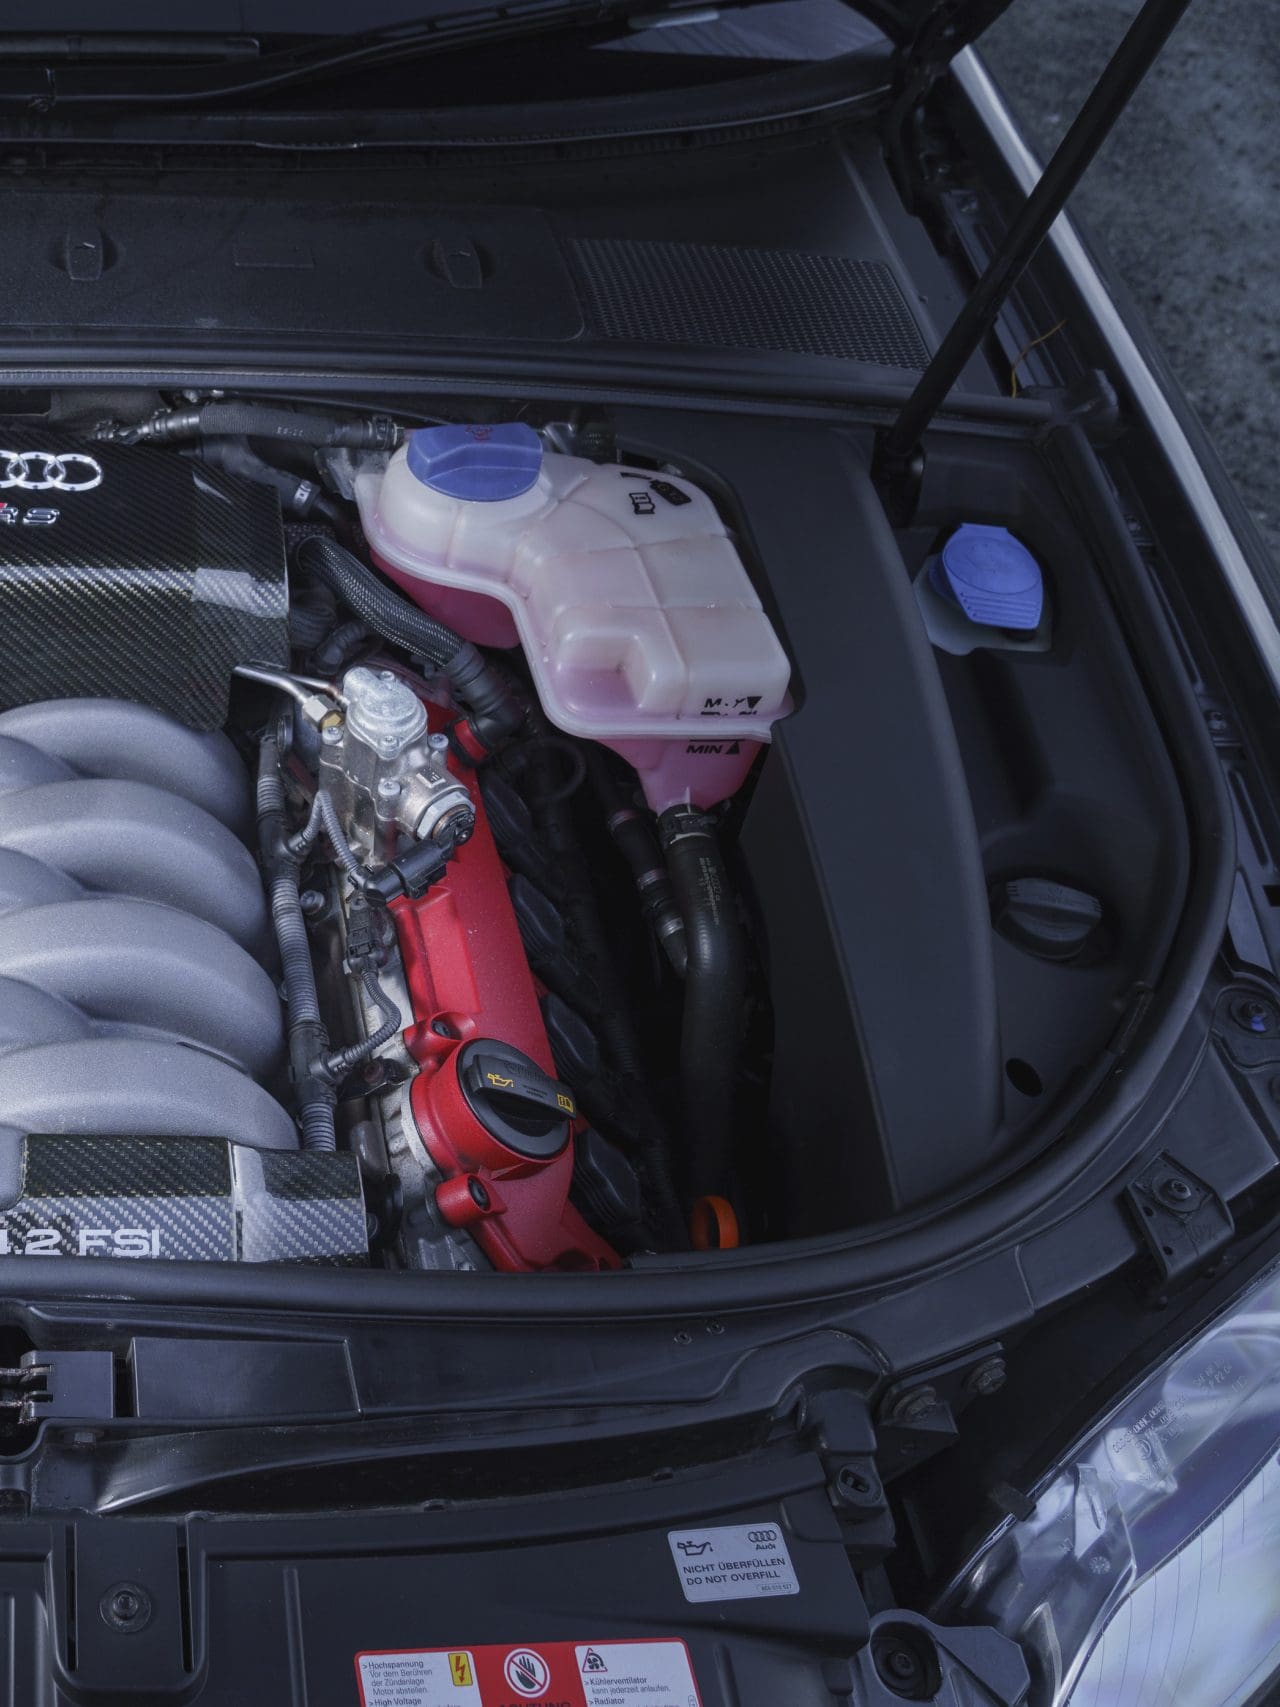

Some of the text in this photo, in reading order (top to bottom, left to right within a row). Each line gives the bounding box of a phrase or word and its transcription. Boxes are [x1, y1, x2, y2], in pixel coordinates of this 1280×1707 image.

[686, 745, 723, 754] MIN
[77, 1229, 160, 1257] FSI
[683, 1558, 786, 1574] NICHT ÜBERFÜLLEN
[686, 1571, 780, 1586] DO NOT OVERFILL
[369, 1661, 424, 1669] Hochspannung
[383, 1670, 399, 1678] dem
[384, 1678, 425, 1687] Zündanlage
[589, 1677, 647, 1686] Kühlerventilator
[591, 1687, 609, 1695] kann
[609, 1686, 639, 1695] jederzeit
[374, 1698, 422, 1707] High Voltage
[594, 1697, 625, 1705] Radiator
